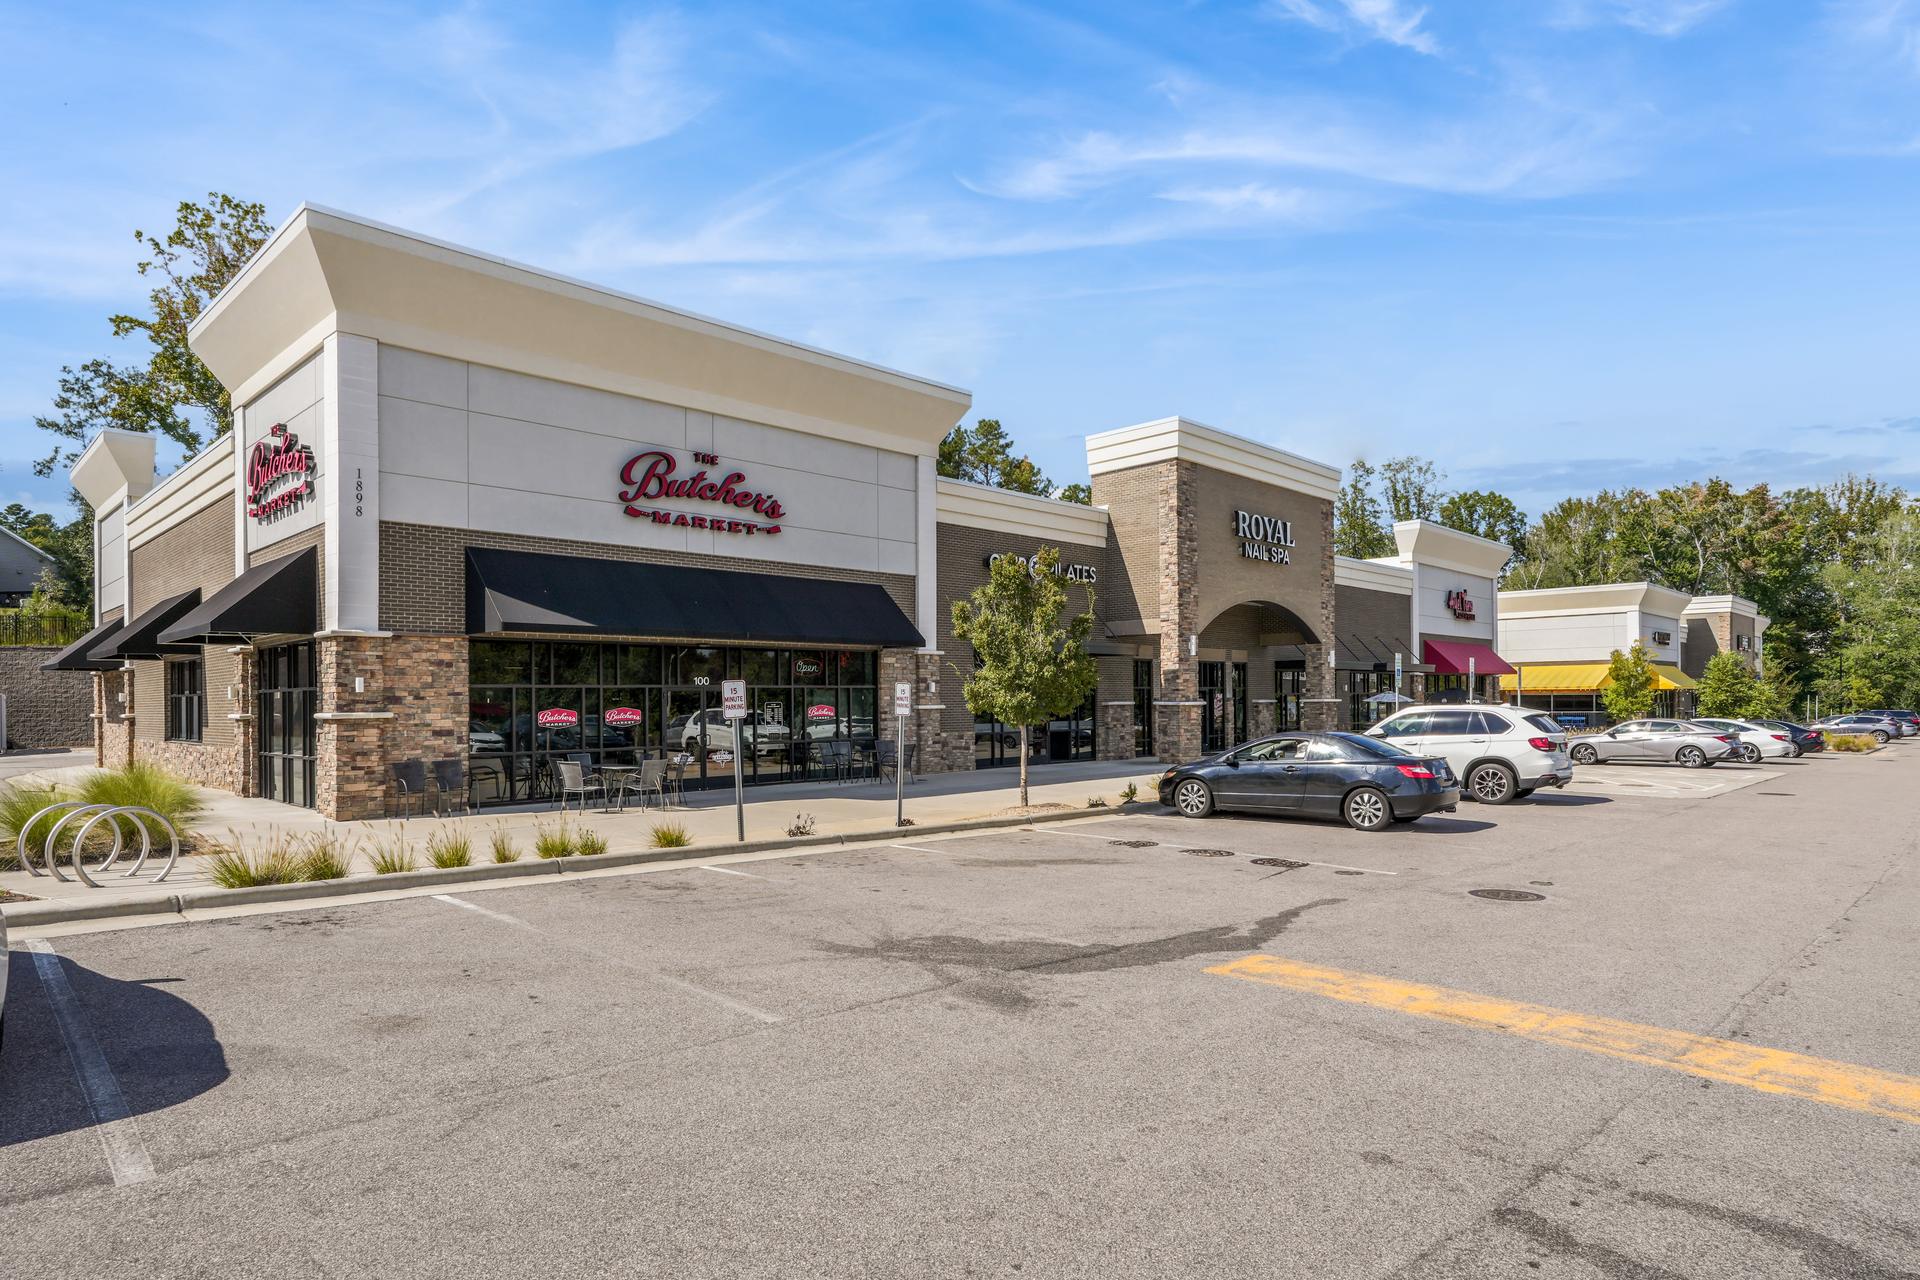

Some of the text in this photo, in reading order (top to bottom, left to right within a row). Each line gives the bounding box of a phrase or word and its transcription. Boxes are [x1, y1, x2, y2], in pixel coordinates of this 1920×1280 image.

[693, 451, 719, 466] THE
[257, 489, 299, 517] MARKET
[355, 468, 363, 517] 1898
[651, 510, 758, 535] MARKET
[1236, 510, 1296, 547] ROYAL
[1245, 541, 1291, 566] NAIL SPA
[796, 661, 819, 674] Open
[693, 676, 710, 686] 100
